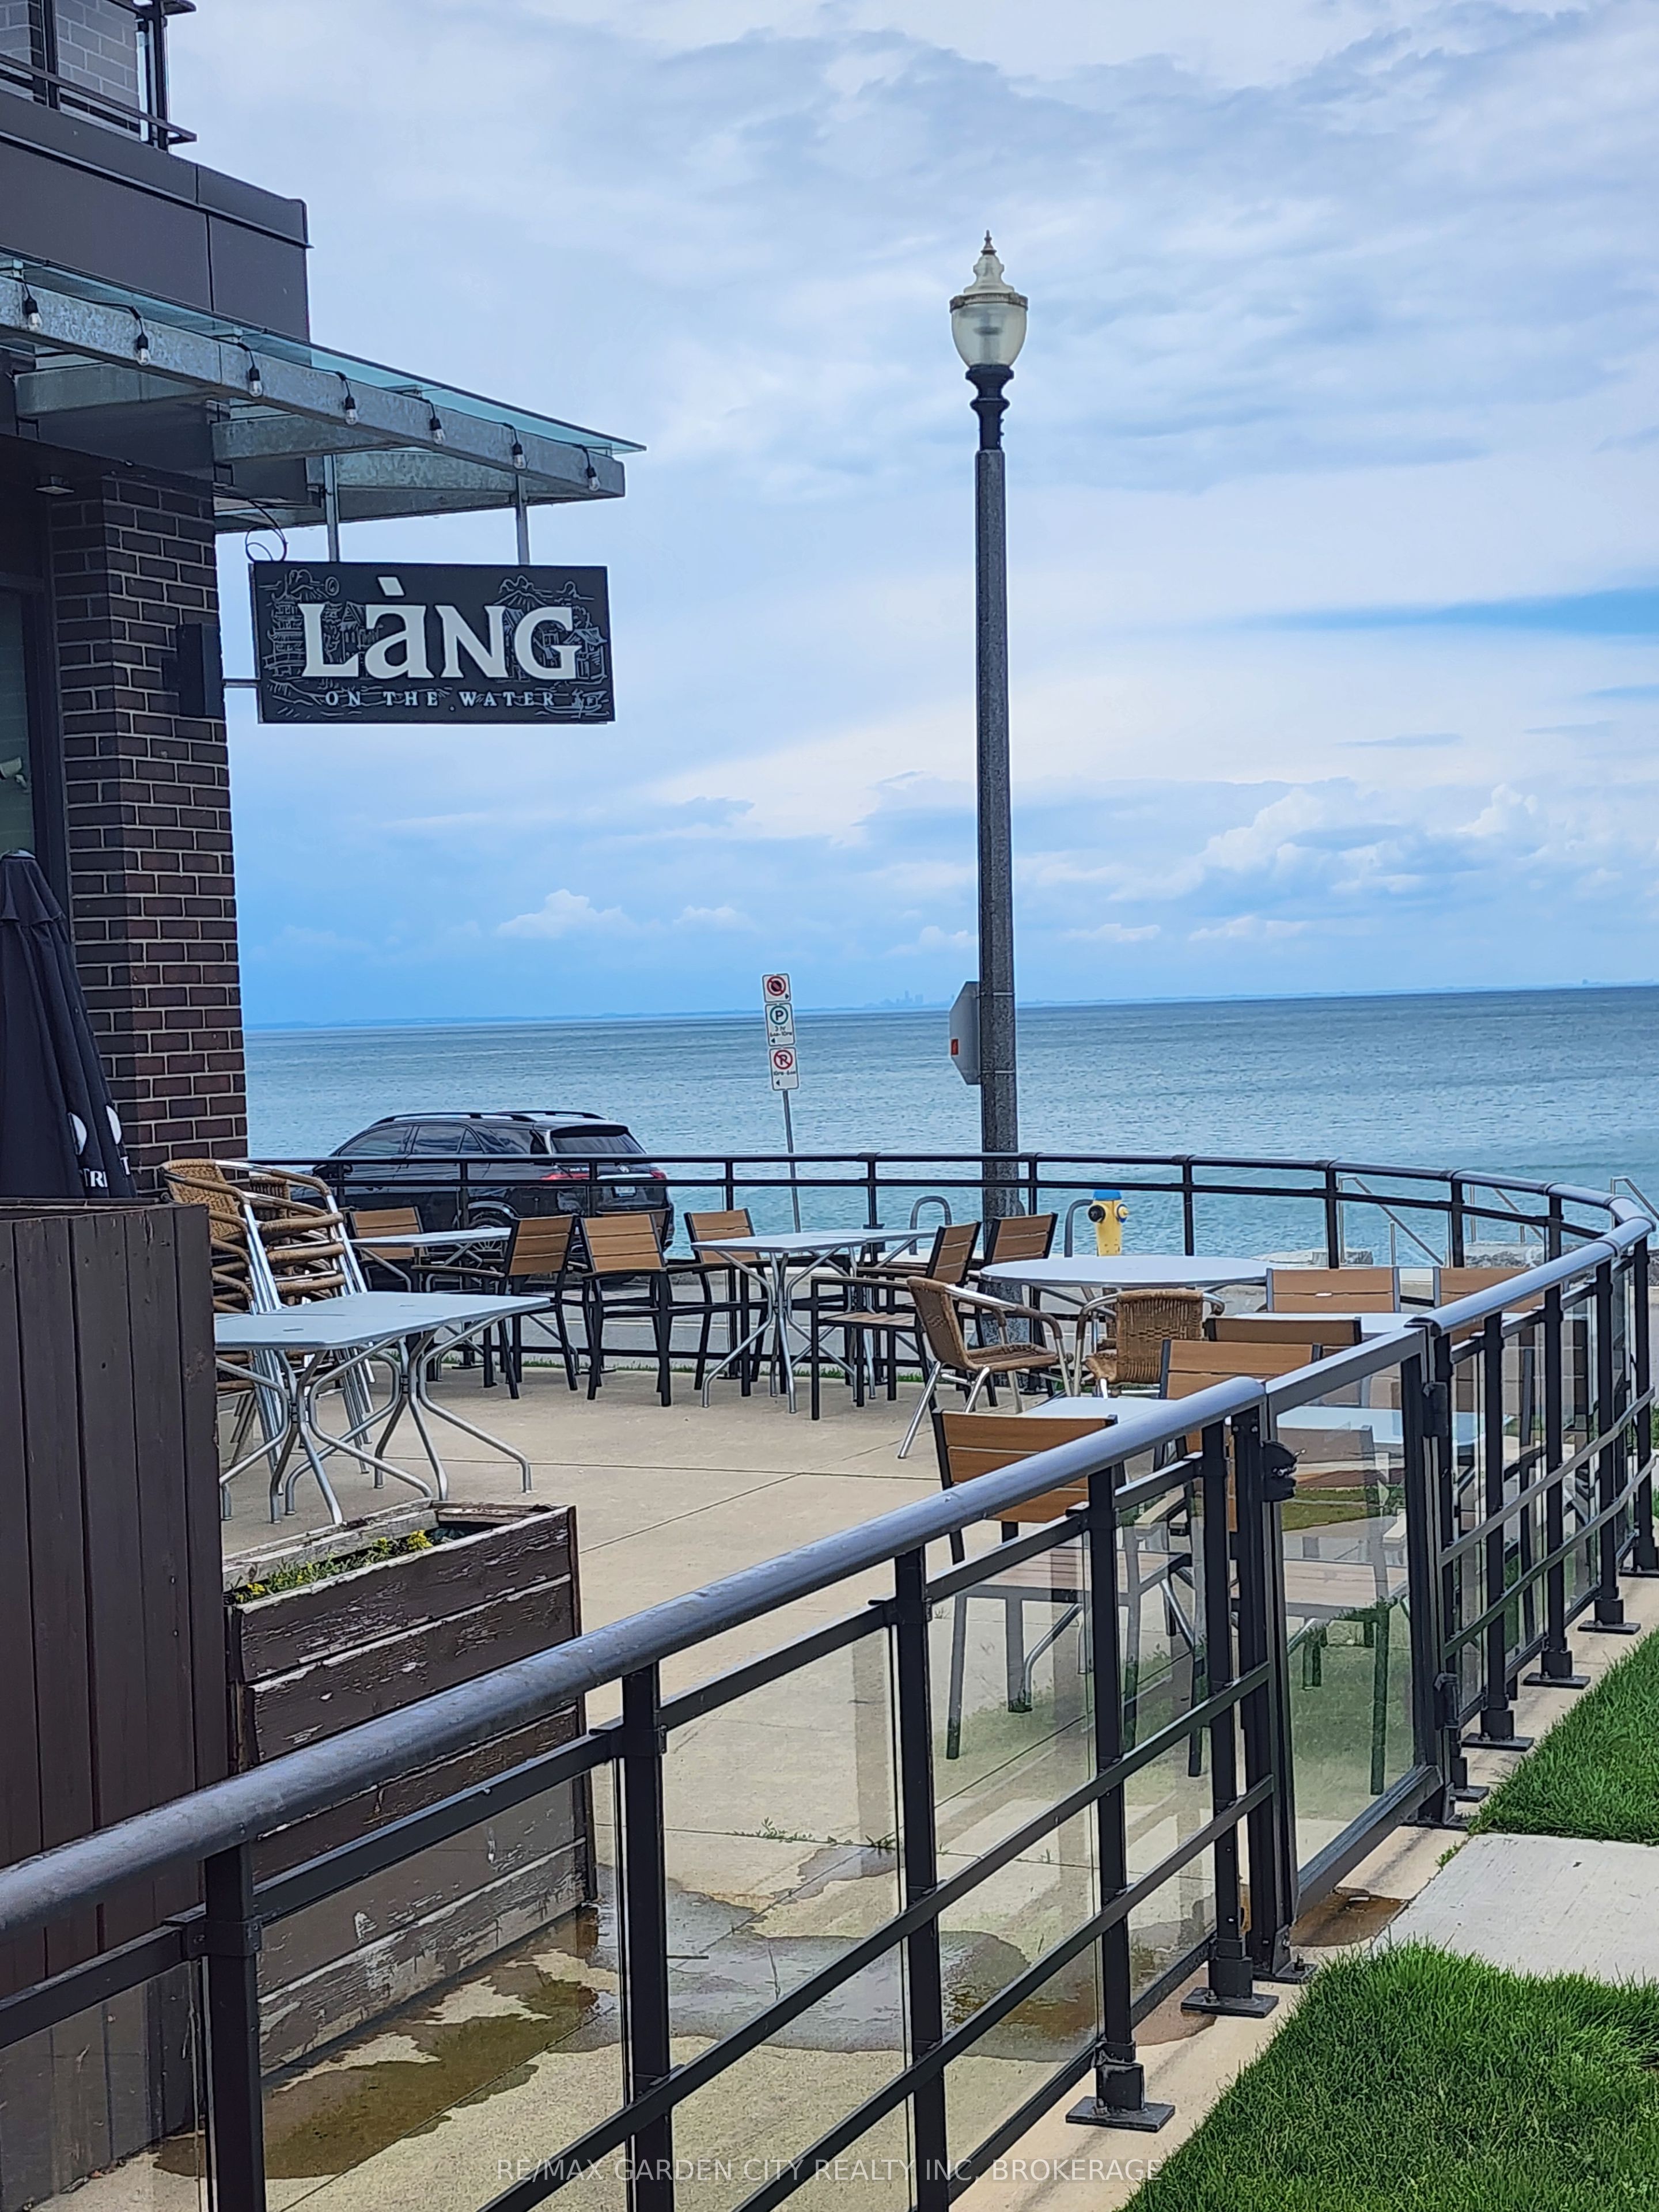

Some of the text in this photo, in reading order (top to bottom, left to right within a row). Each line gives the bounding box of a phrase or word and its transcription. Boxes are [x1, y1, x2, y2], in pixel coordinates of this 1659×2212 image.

[325, 691, 555, 706] ON THE WATER
[775, 1010, 784, 1021] P
